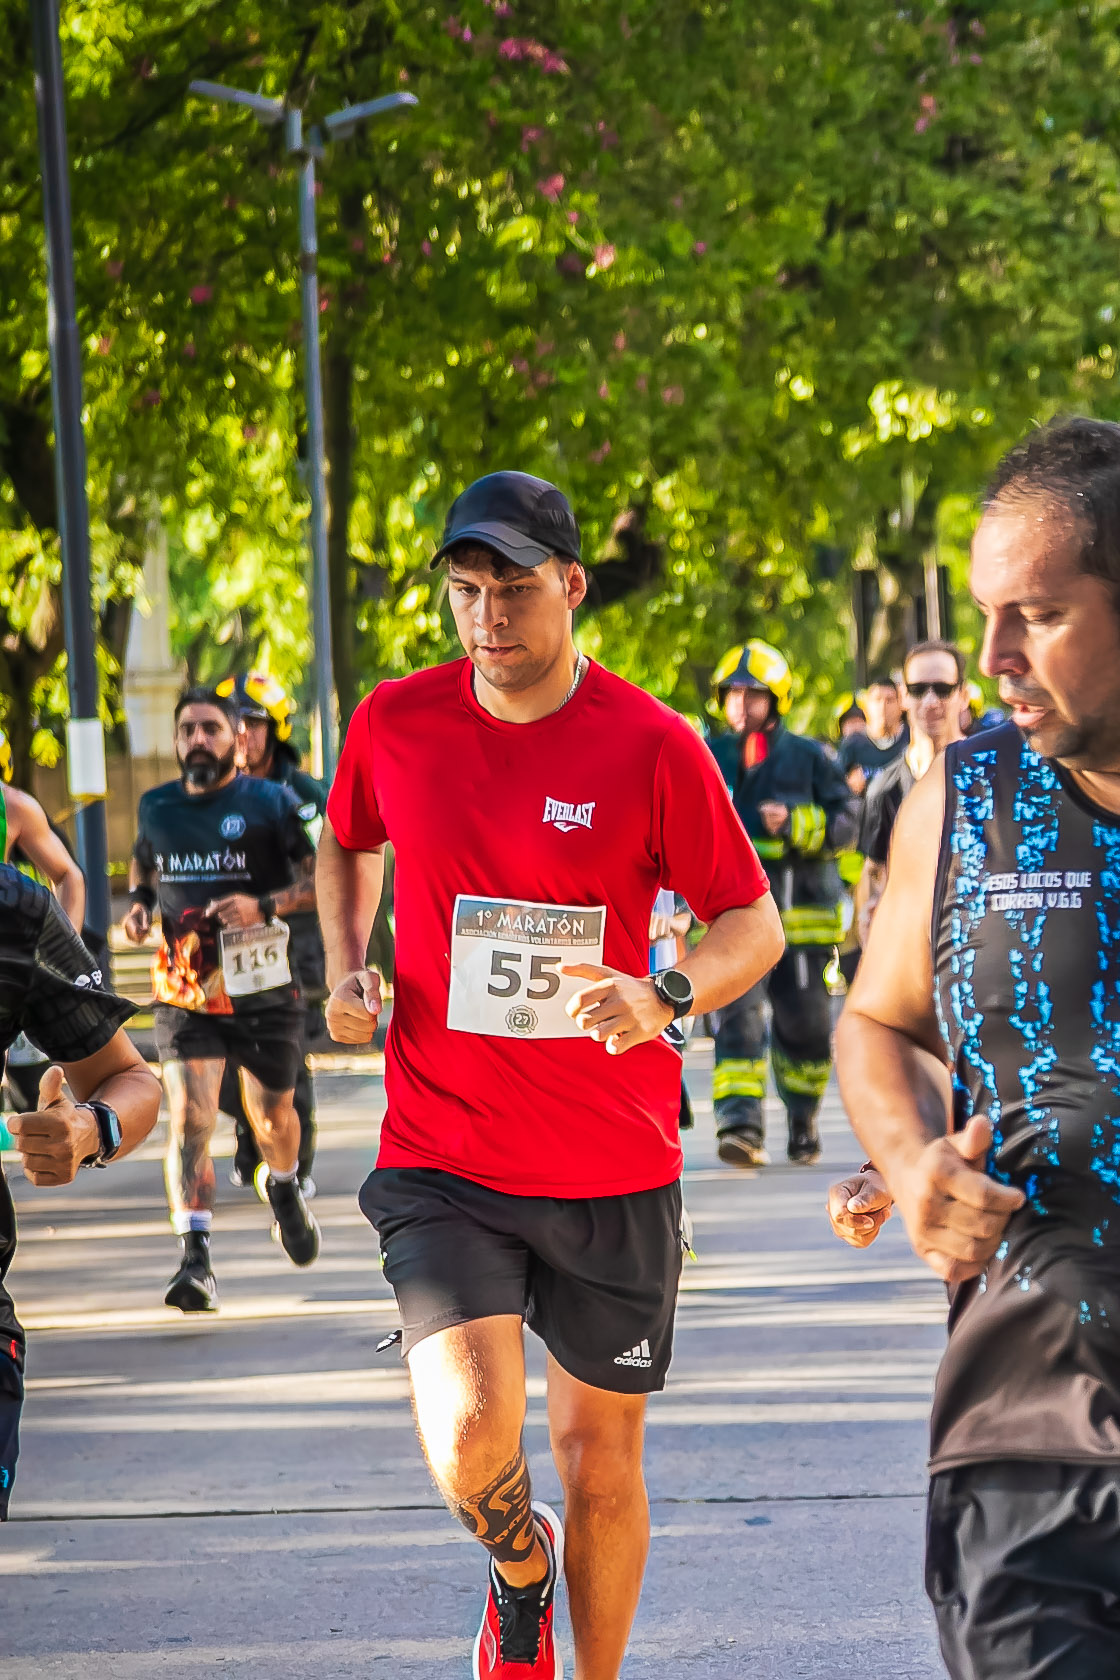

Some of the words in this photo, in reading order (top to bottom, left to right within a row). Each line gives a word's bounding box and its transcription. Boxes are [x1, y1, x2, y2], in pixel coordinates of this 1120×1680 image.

[542, 796, 596, 829] EVERLAST
[1020, 872, 1063, 888] LOCOS
[1065, 871, 1092, 889] QUE
[991, 892, 1043, 911] CORREN
[497, 912, 585, 936] MARATÓN
[487, 949, 562, 1000] 55
[613, 1356, 652, 1368] adidas
